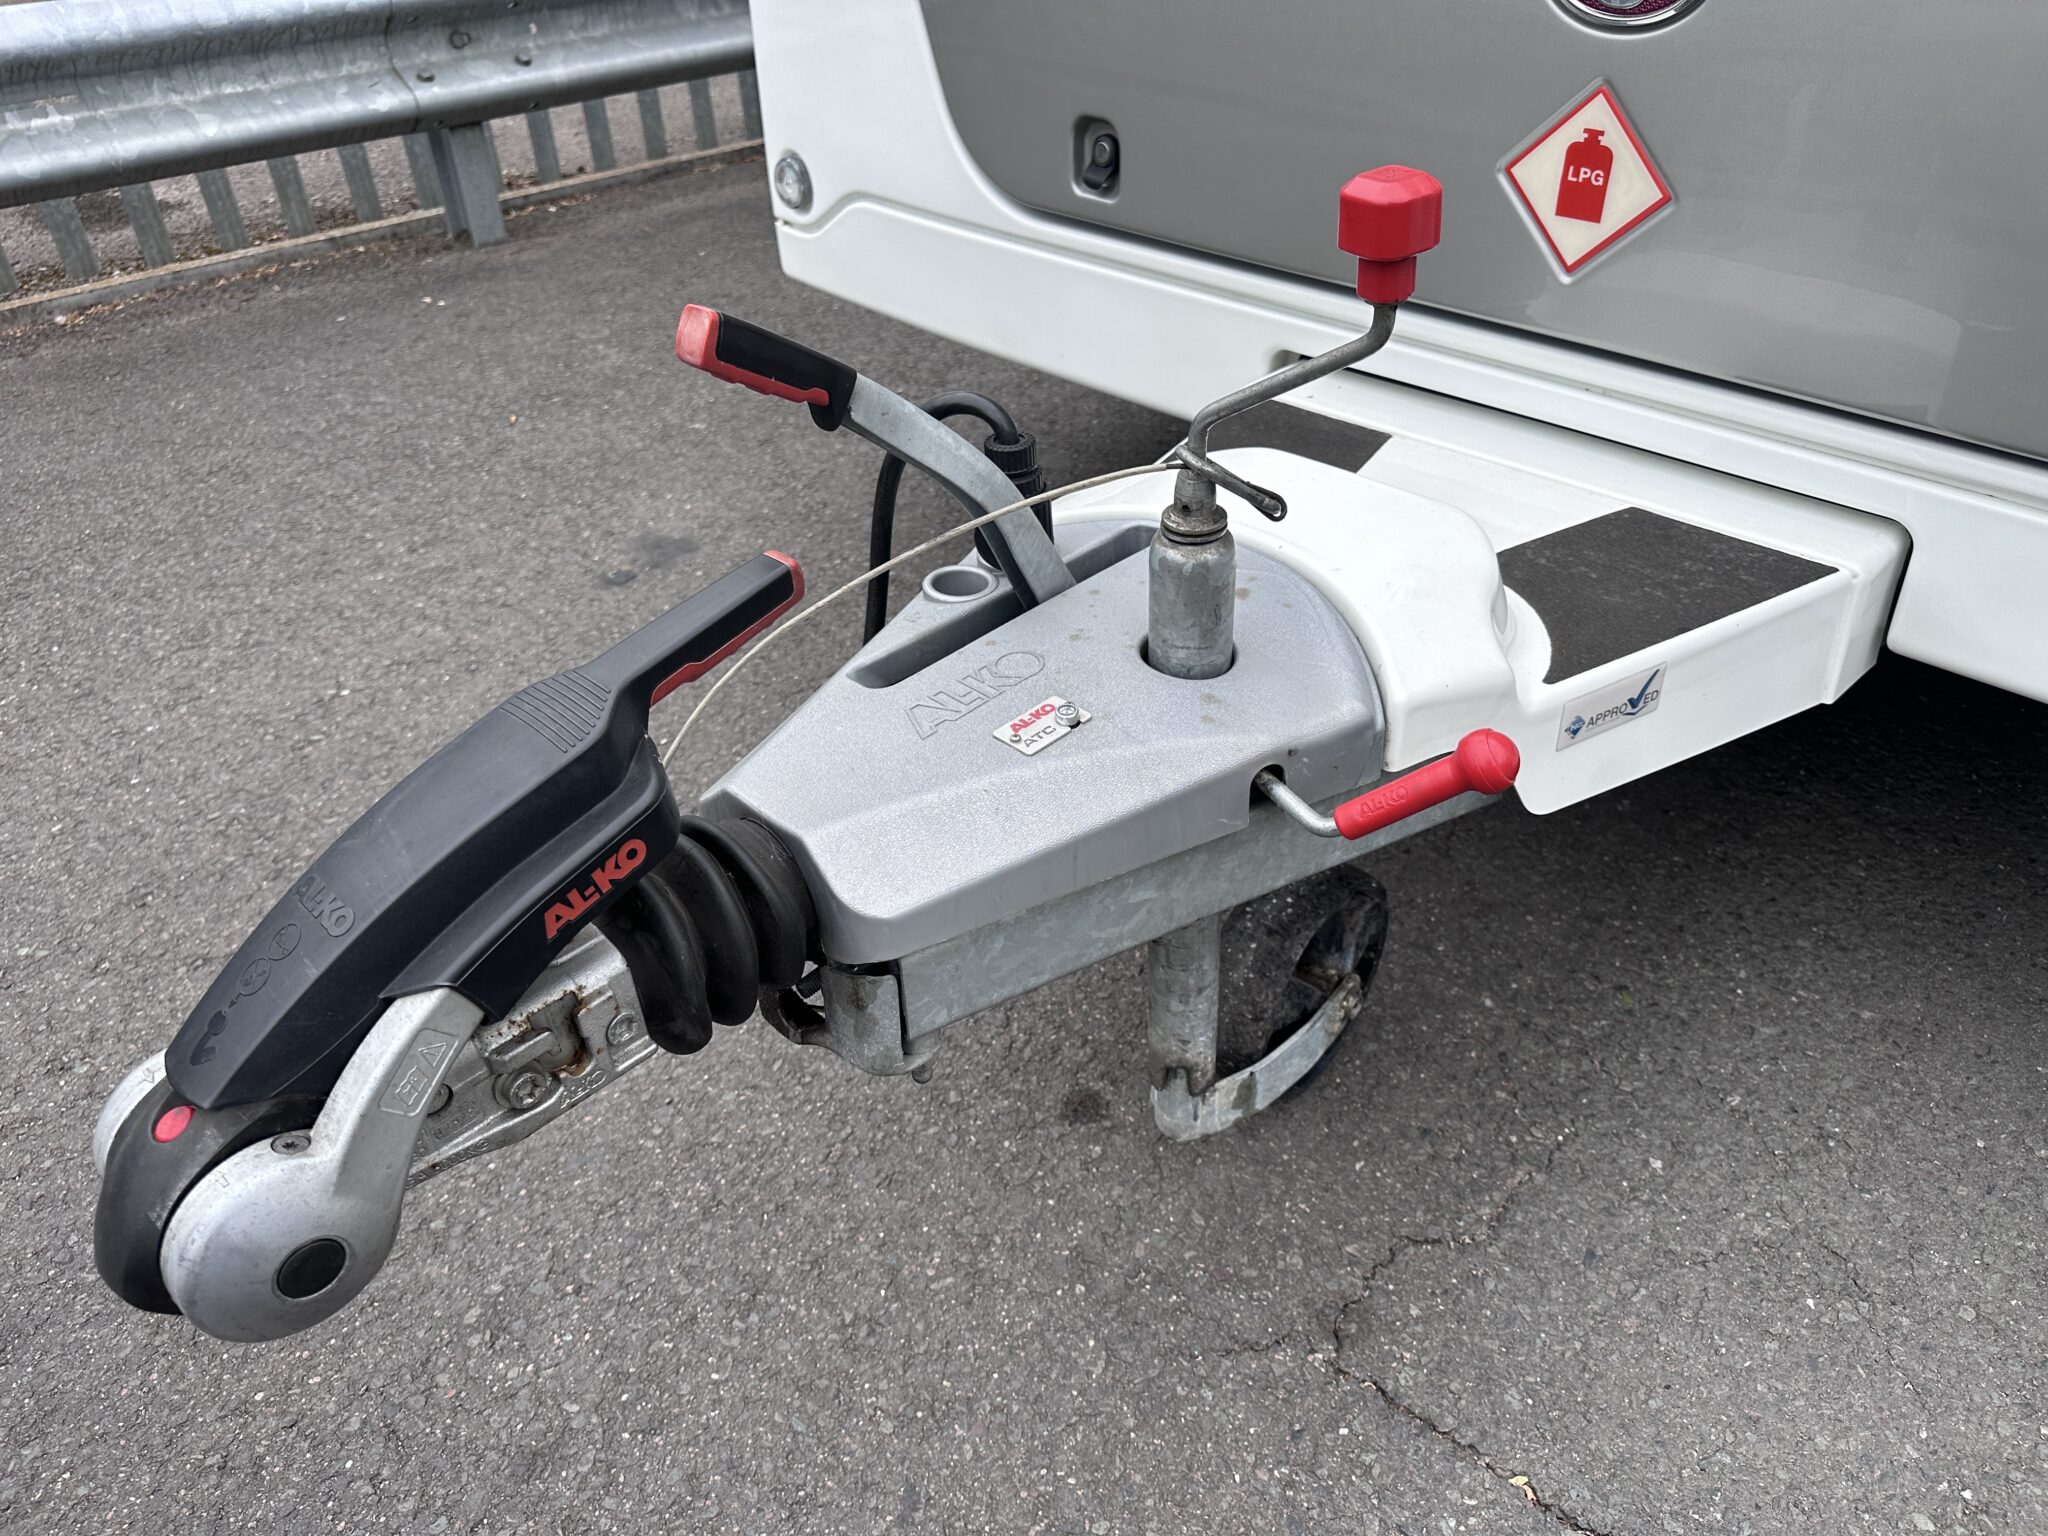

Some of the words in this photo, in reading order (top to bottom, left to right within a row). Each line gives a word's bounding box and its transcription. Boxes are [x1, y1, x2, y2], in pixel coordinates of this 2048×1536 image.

[1567, 165, 1605, 186] LPG
[1586, 670, 1660, 729] APPROVED
[1010, 703, 1056, 734] AL-KO
[1023, 725, 1057, 748] ATC
[544, 838, 647, 940] AL-KO
